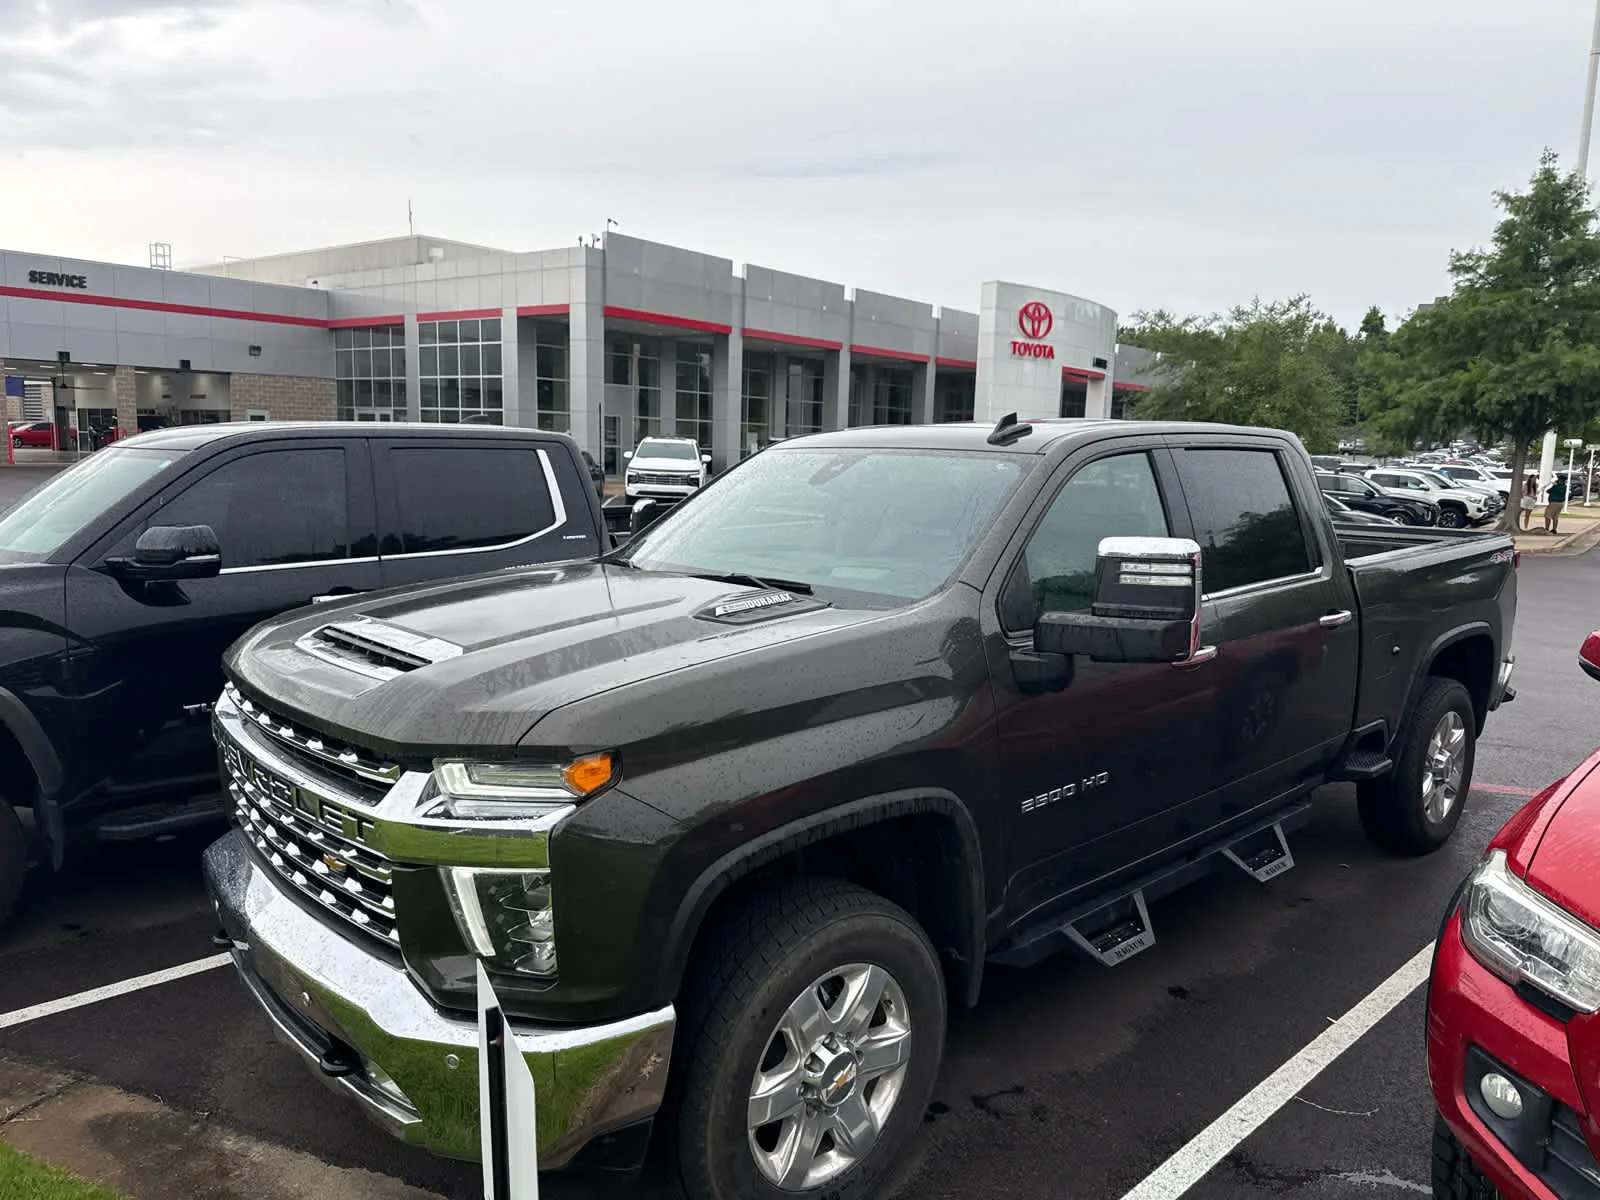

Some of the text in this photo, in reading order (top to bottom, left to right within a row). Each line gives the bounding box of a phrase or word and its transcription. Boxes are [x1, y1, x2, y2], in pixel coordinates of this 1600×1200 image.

[28, 270, 88, 289] SERVICE
[1010, 340, 1055, 359] TOYOTA
[747, 593, 793, 609] DURAMAX
[1021, 771, 1109, 814] 2500 HD
